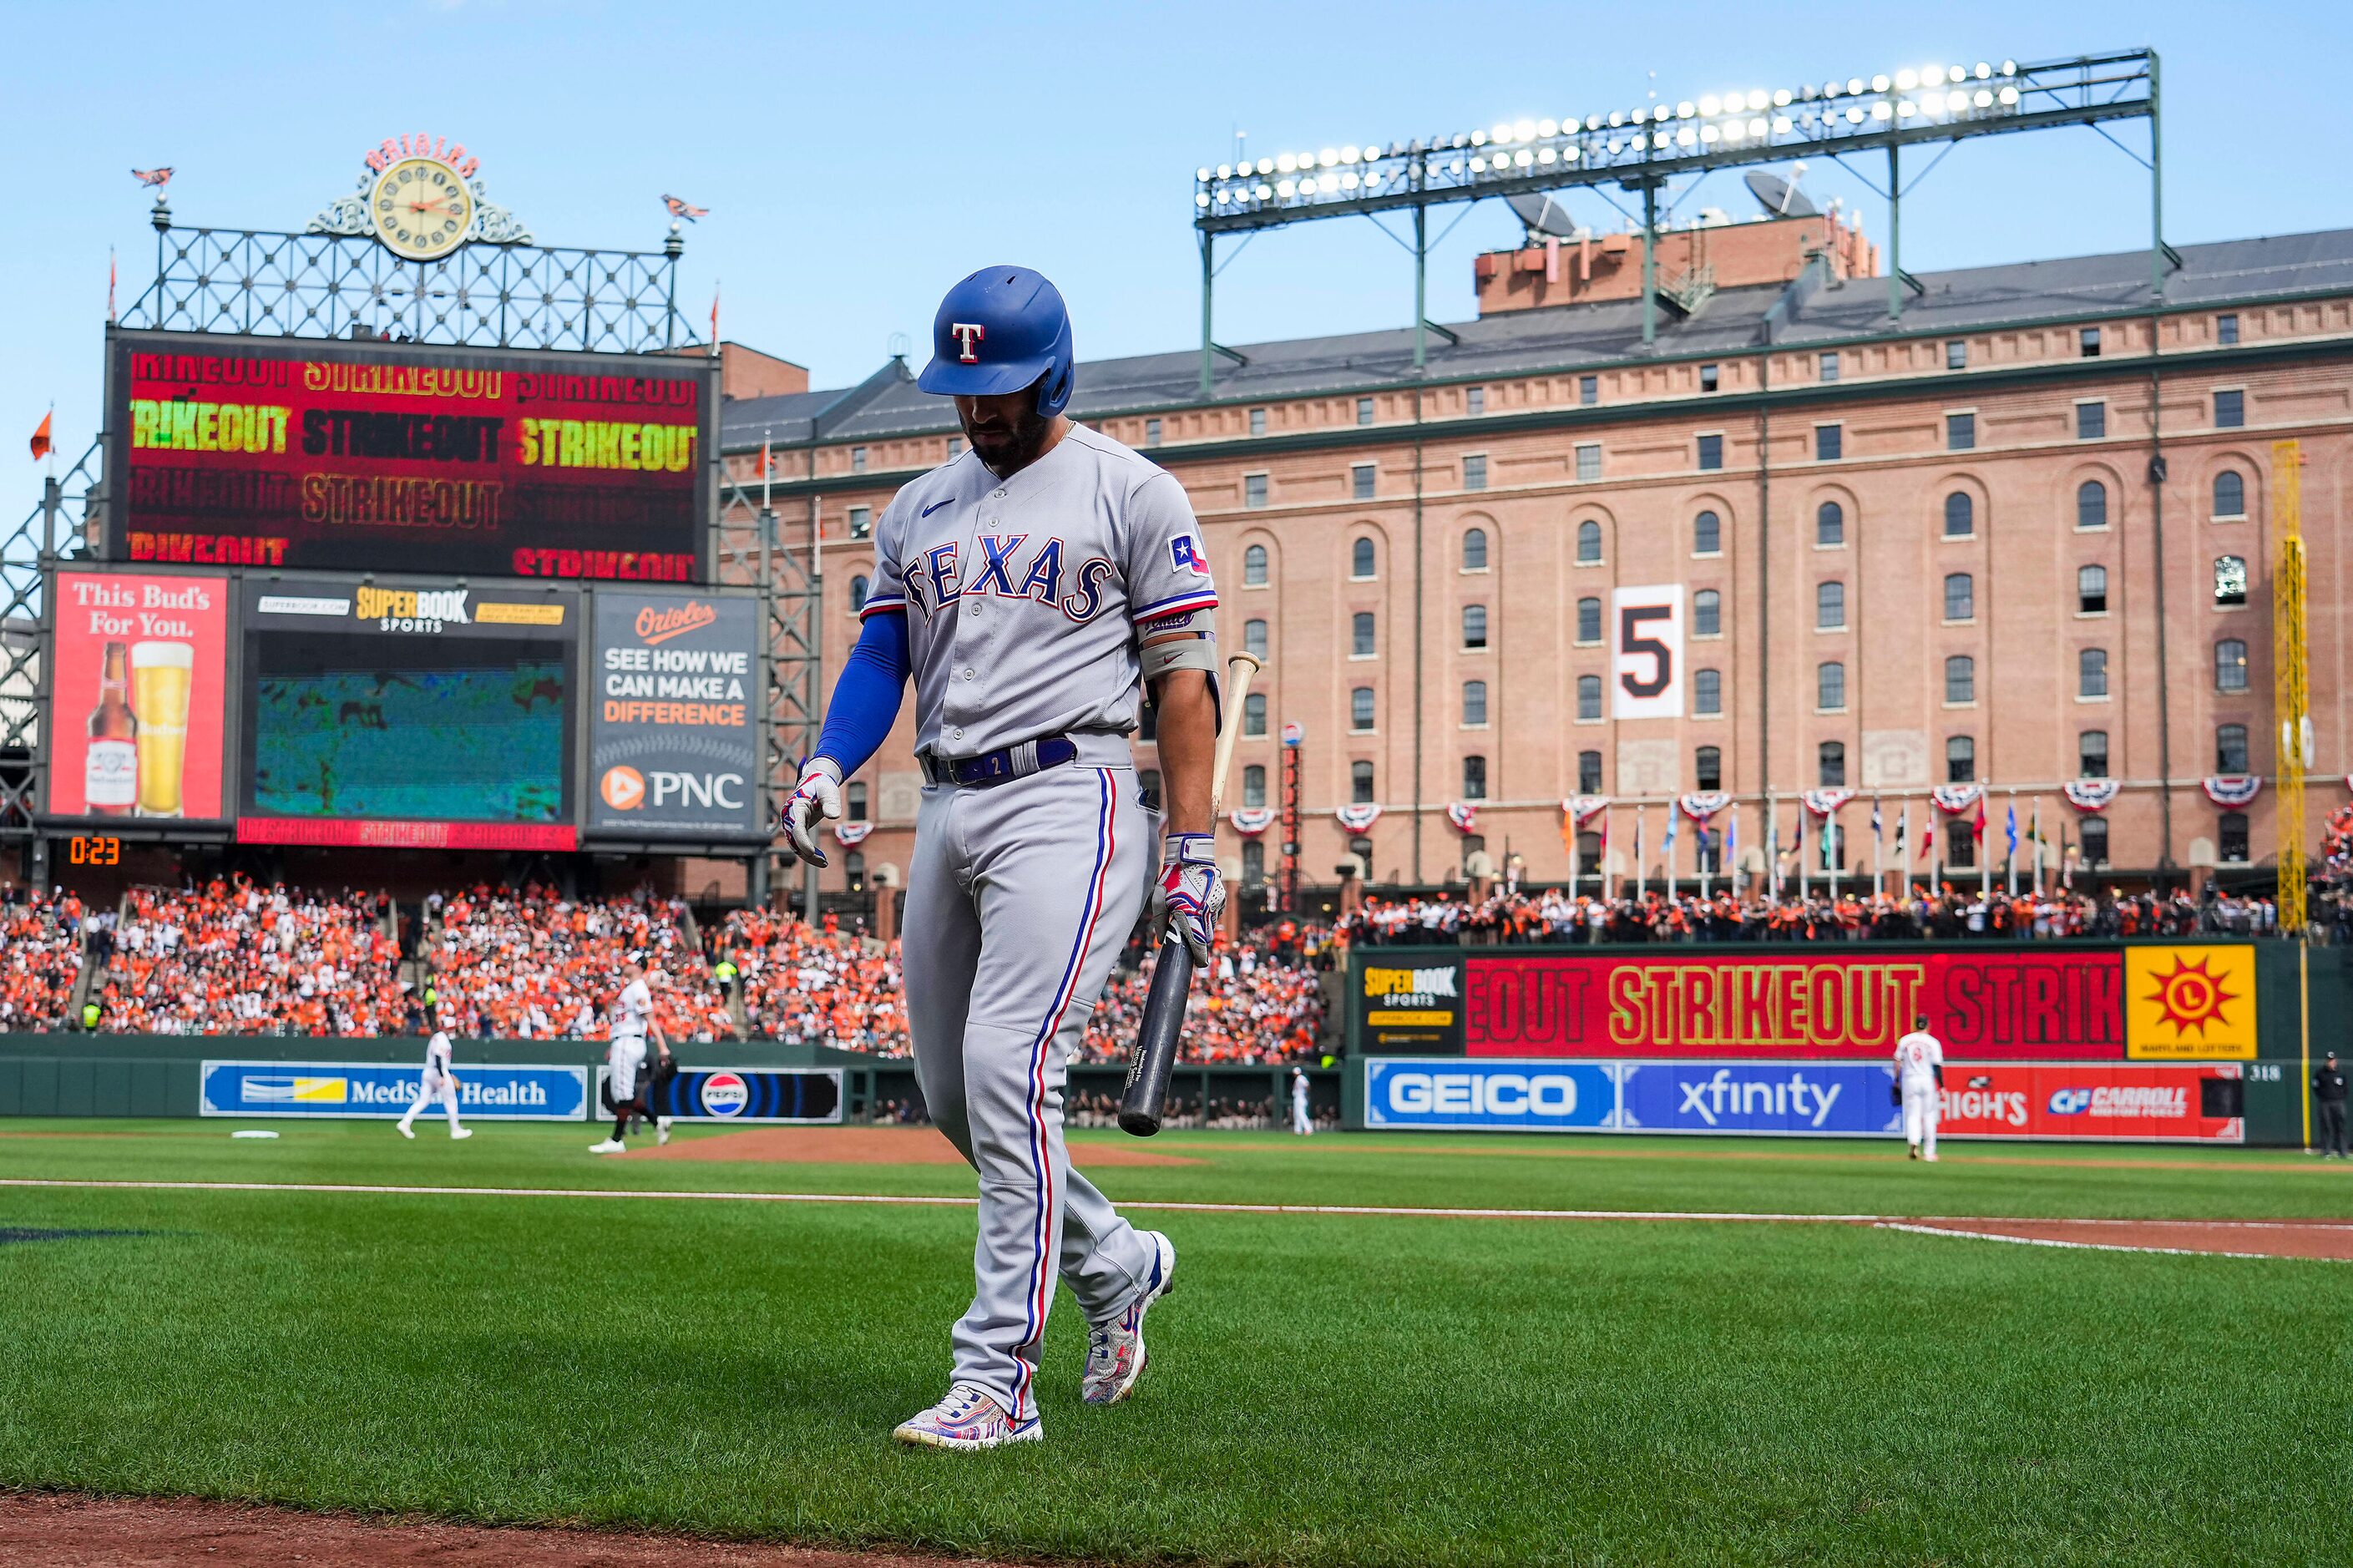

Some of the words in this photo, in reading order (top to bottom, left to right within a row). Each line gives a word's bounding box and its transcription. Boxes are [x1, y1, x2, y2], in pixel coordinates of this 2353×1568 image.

[365, 132, 481, 179] ORIOLES
[952, 322, 985, 365] T
[303, 360, 502, 400] STRIKEOUT
[302, 408, 504, 464] STRIKEOUT
[301, 471, 503, 530] STRIKEOUT
[72, 581, 135, 608] This
[142, 584, 210, 610] Bud's
[901, 533, 1114, 628] TEXAS
[356, 586, 470, 624] SUPERBOOK
[635, 600, 717, 640] Orioles
[89, 609, 134, 635] For
[139, 613, 195, 638] You.
[380, 618, 443, 634] SPORTS
[605, 647, 650, 671] SEE
[652, 649, 709, 673] HOW
[710, 651, 749, 675] WE
[1619, 603, 1672, 700] 5
[605, 674, 656, 698] CAN
[658, 675, 725, 700] MAKE
[725, 678, 745, 701] A
[604, 700, 746, 726] DIFFERENCE
[991, 756, 1002, 776] 2
[649, 771, 745, 809] PNC
[70, 837, 120, 865] 0:23
[1364, 966, 1457, 998] SUPERBOOK
[2181, 984, 2203, 1008] L
[1383, 993, 1436, 1007] SPORTS
[1608, 964, 1925, 1045] STRIKEOUT
[2140, 1044, 2194, 1054] MARYLAND
[2249, 1064, 2282, 1082] 318
[461, 1080, 547, 1105] Health
[1388, 1072, 1577, 1117] GEICO
[1678, 1068, 1842, 1128] xfinity
[1936, 1090, 2029, 1127] HIGH'S
[2091, 1086, 2188, 1106] CARROLL
